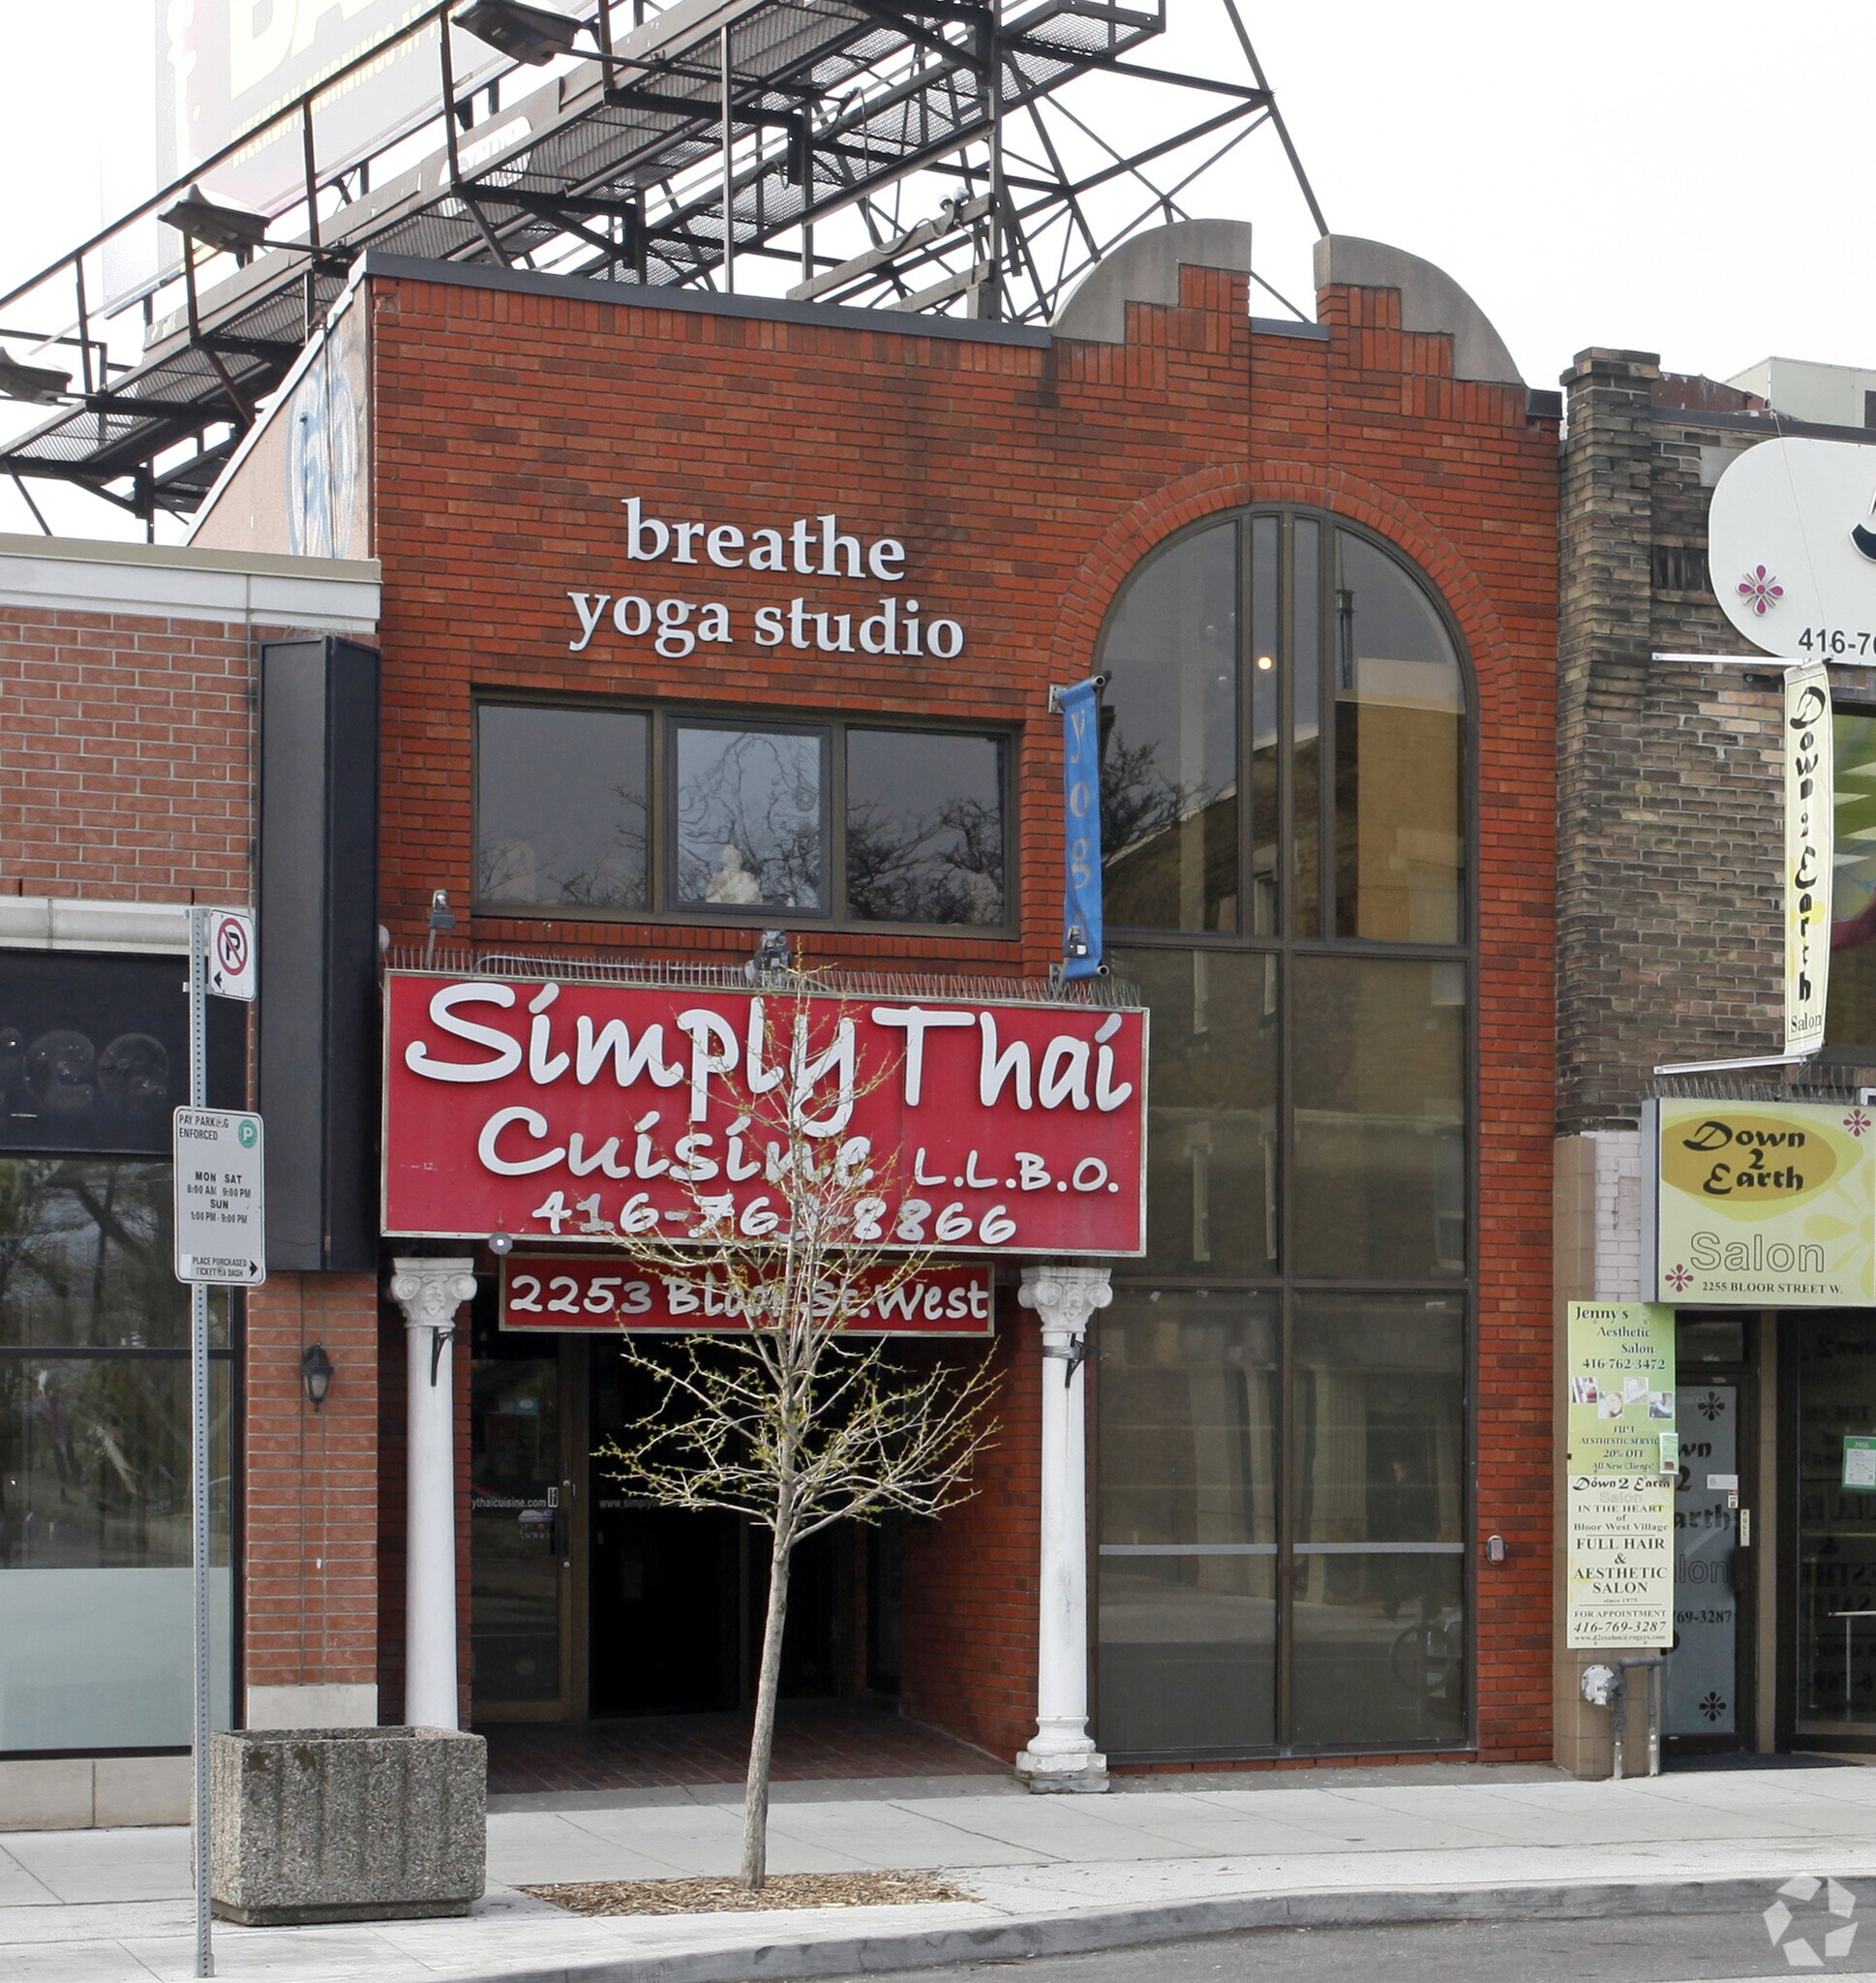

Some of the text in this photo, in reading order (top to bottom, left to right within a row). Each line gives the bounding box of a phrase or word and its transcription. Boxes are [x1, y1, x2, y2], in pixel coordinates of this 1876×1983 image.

[621, 496, 906, 581] breathe
[567, 591, 965, 659] yoga studio
[1798, 627, 1876, 656] 416-7
[1788, 686, 1827, 801] Down
[1794, 845, 1817, 1004] Earth
[1790, 1011, 1822, 1034] Salon
[404, 982, 1134, 1139] Simply Thai
[179, 1114, 229, 1129] PAY PARKG
[179, 1127, 219, 1141] ENFORCED
[1681, 1120, 1805, 1152] Down
[477, 1105, 1120, 1193] Cuisine L.L.B.O.
[1747, 1147, 1766, 1171] 2
[196, 1171, 243, 1184] MON SAT
[1702, 1162, 1804, 1196] Earth
[187, 1184, 204, 1195] 8:00
[222, 1187, 239, 1198] 9:00
[239, 1188, 252, 1199] PM
[209, 1199, 229, 1209] SUN
[191, 1211, 204, 1221] 1:00
[205, 1211, 217, 1222] PM
[221, 1213, 237, 1223] 9:00
[237, 1214, 248, 1224] PM
[1689, 1231, 1825, 1273] Salon
[193, 1257, 248, 1267] PLACE PURCHASED
[196, 1267, 217, 1276] TICKET
[227, 1268, 244, 1277] DASH
[509, 1274, 653, 1316] 2253
[1702, 1281, 1843, 1295] 2255 BLOOR STREET W.
[1576, 1306, 1629, 1324] Jenny's
[1596, 1327, 1650, 1337] Aesthetic
[1620, 1342, 1654, 1355] Salon
[1625, 1449, 1644, 1458] OFF
[1572, 1477, 1671, 1492] Down 2 Earth
[471, 1496, 547, 1510] ythaicuisine.com
[1599, 1492, 1643, 1503] Salon
[1616, 1513, 1627, 1522] of
[1675, 1504, 1731, 1531] arth
[1633, 1523, 1669, 1533] Village
[1576, 1538, 1666, 1550] FULL HAIR
[1614, 1552, 1627, 1565] &
[1573, 1567, 1668, 1579] AESTHETIC
[1592, 1581, 1649, 1594] SALON
[1595, 1609, 1667, 1618] APPOINTMENT
[1573, 1621, 1667, 1633] 416-769-3287
